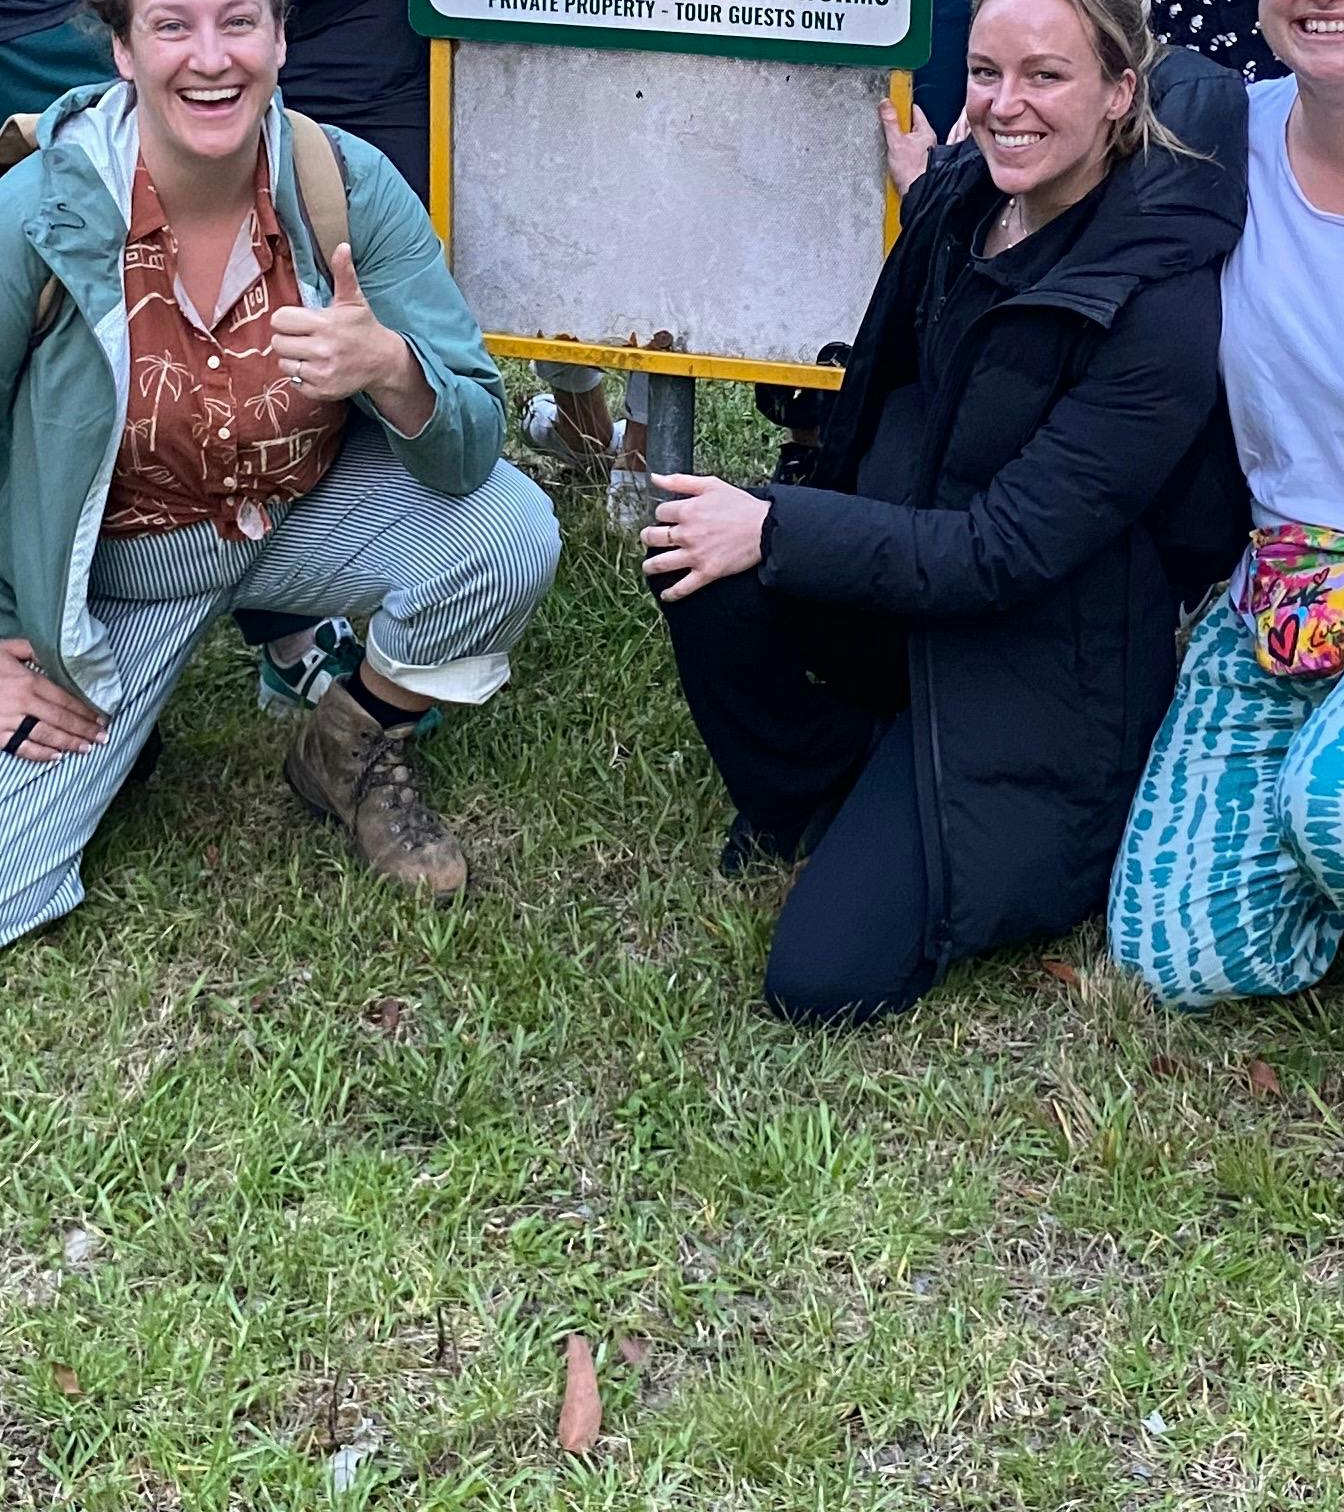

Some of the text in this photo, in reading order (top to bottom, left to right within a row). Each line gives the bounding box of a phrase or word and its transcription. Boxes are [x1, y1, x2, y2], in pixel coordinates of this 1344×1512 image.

[675, 3, 722, 23] TOUR
[729, 6, 794, 28] GUESTS
[801, 11, 846, 32] ONLY
